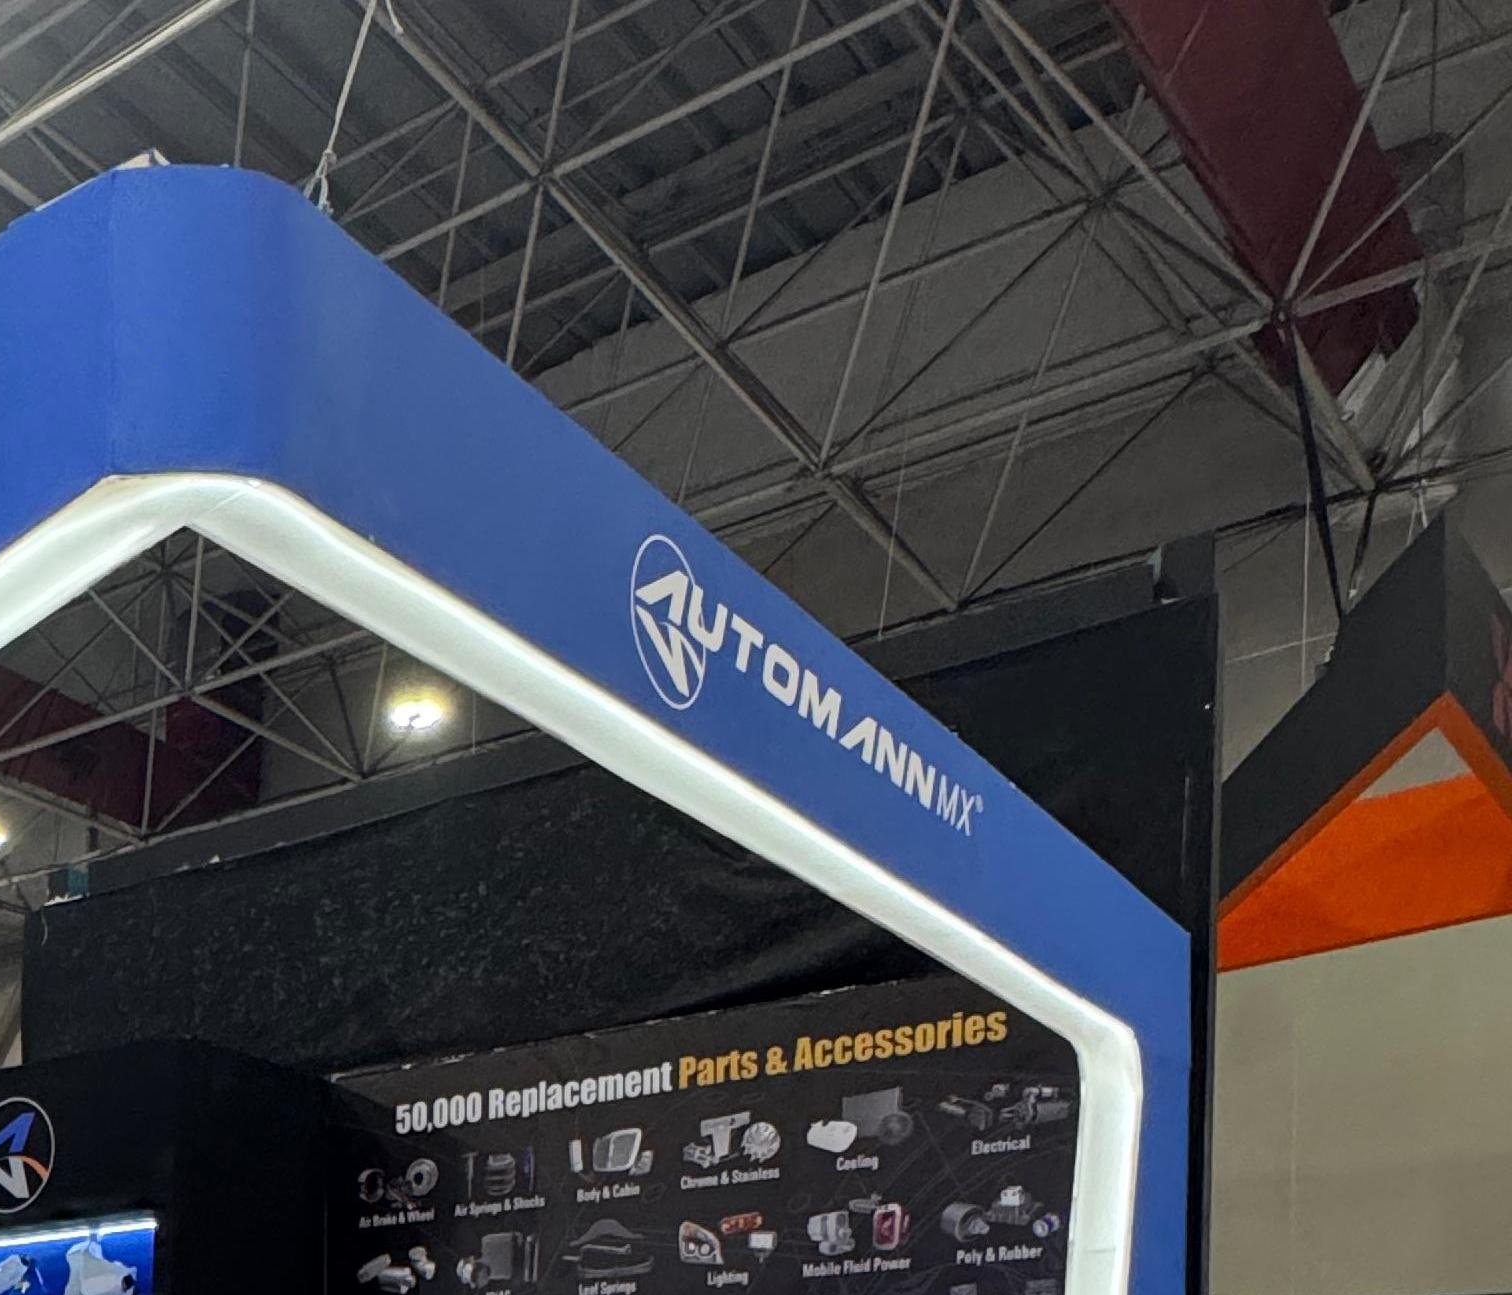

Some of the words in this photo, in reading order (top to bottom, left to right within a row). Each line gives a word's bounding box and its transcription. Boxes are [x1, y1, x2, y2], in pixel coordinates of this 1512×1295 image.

[635, 570, 937, 811] AUTOMANN
[395, 1091, 483, 1135] 50,000
[488, 1060, 674, 1121] Replacement
[678, 1049, 759, 1090] Parts
[765, 1046, 789, 1076] &
[793, 1010, 1009, 1073] Accessories
[970, 1134, 1031, 1155] Electrical
[836, 1155, 879, 1171] Cooling
[732, 1166, 780, 1183] Stainless
[576, 1187, 601, 1203] Body
[612, 1183, 640, 1198] Cabin
[469, 1201, 502, 1218] Springs
[956, 1249, 982, 1266] Poly
[985, 1247, 996, 1262] &
[998, 1245, 1043, 1261] Rubber
[802, 1261, 841, 1278] Mobile
[843, 1257, 871, 1274] Fluid
[873, 1256, 912, 1273] Power
[707, 1270, 749, 1288] Lighting
